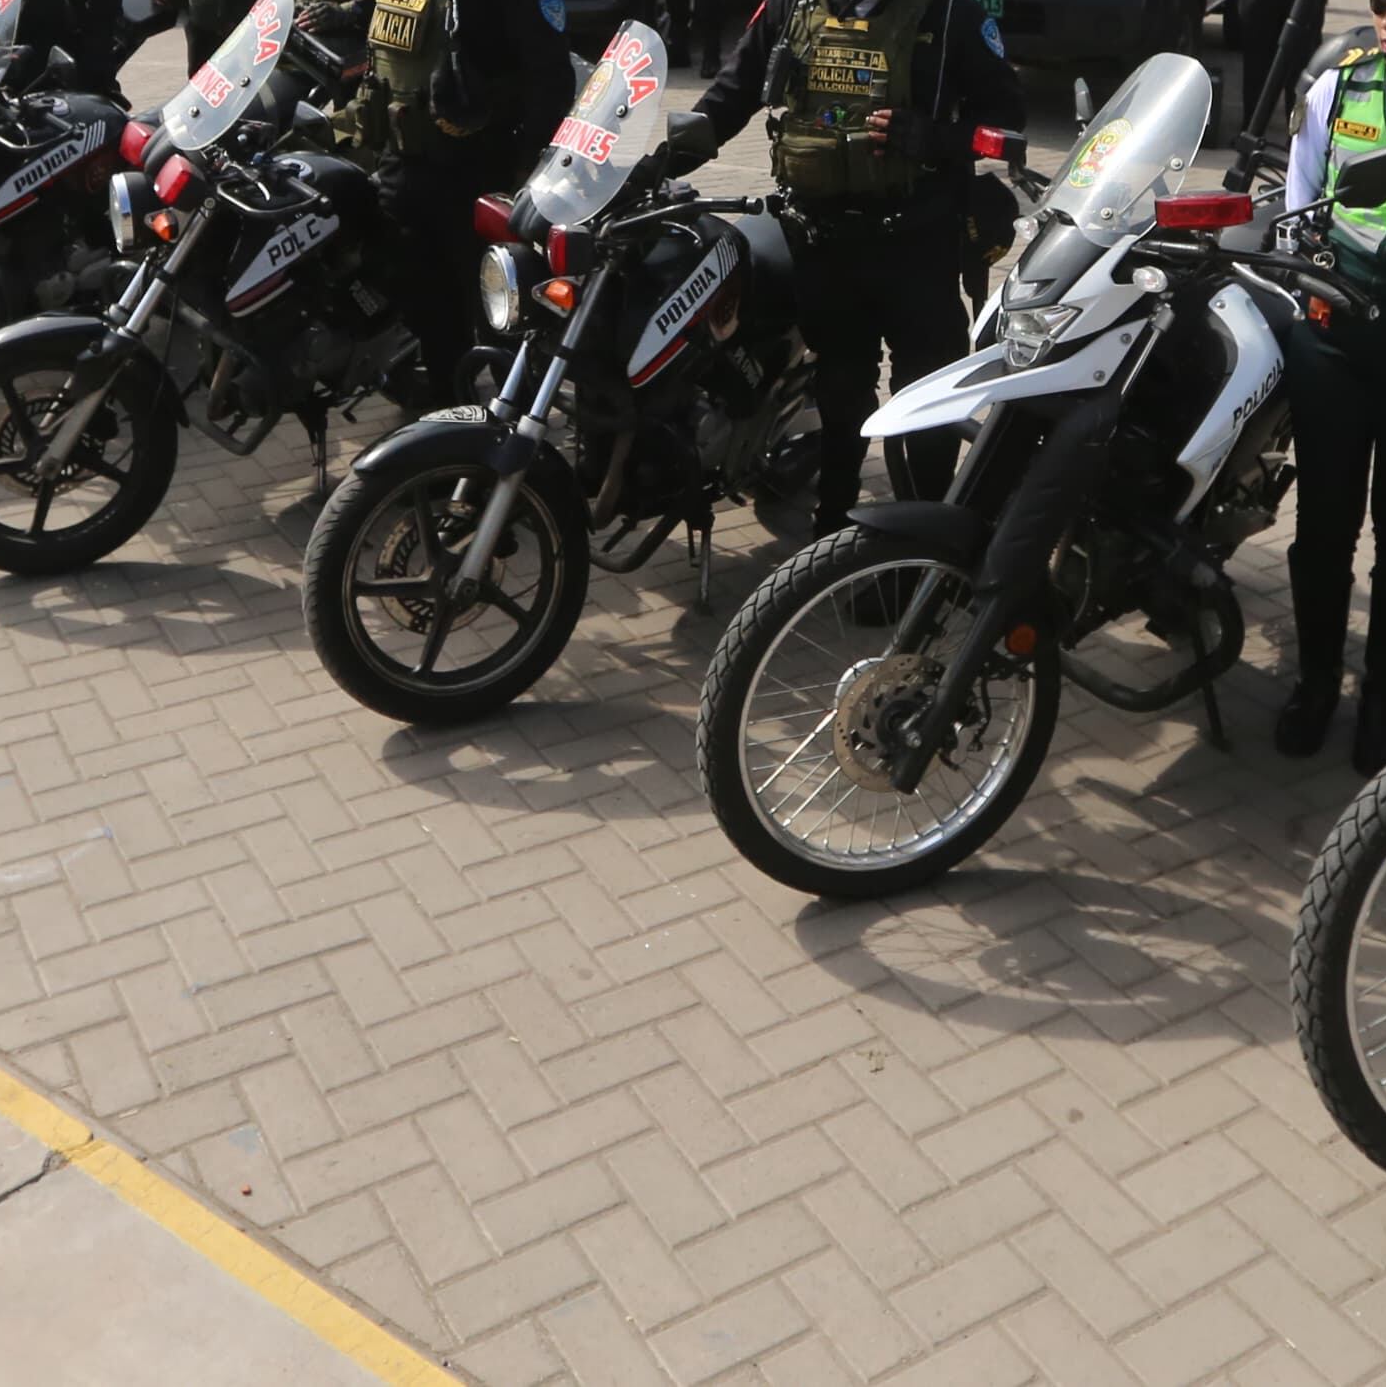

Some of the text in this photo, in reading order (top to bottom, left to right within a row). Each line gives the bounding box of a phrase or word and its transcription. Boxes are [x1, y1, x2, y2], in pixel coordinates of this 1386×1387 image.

[810, 67, 855, 84] POLICIA
[13, 143, 80, 194] POLICIA
[655, 265, 719, 336] POLICIA
[1232, 357, 1284, 430] POLICIA
